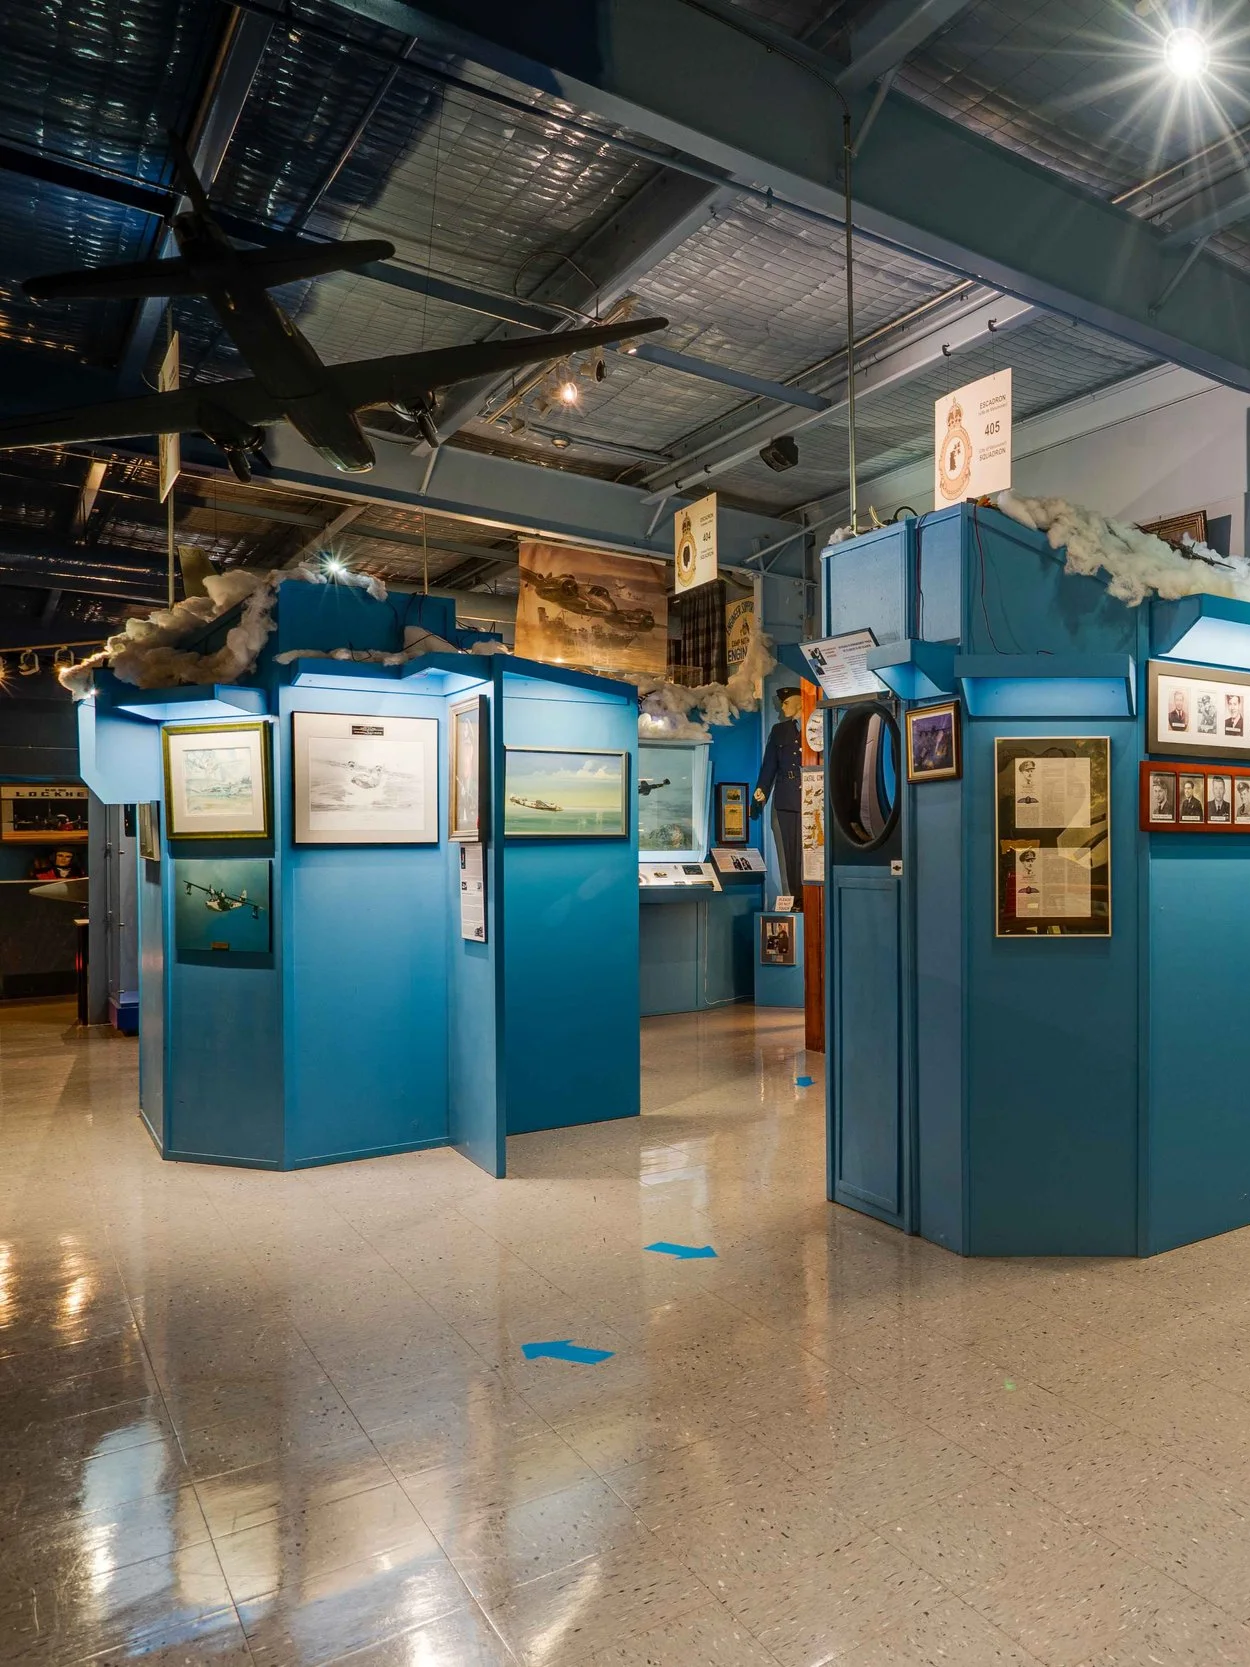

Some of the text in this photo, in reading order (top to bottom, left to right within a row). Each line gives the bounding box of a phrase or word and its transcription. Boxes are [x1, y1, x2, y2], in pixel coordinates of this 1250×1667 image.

[984, 420, 1001, 436] 405
[979, 446, 1006, 462] SQUADRON
[702, 530, 712, 542] 404
